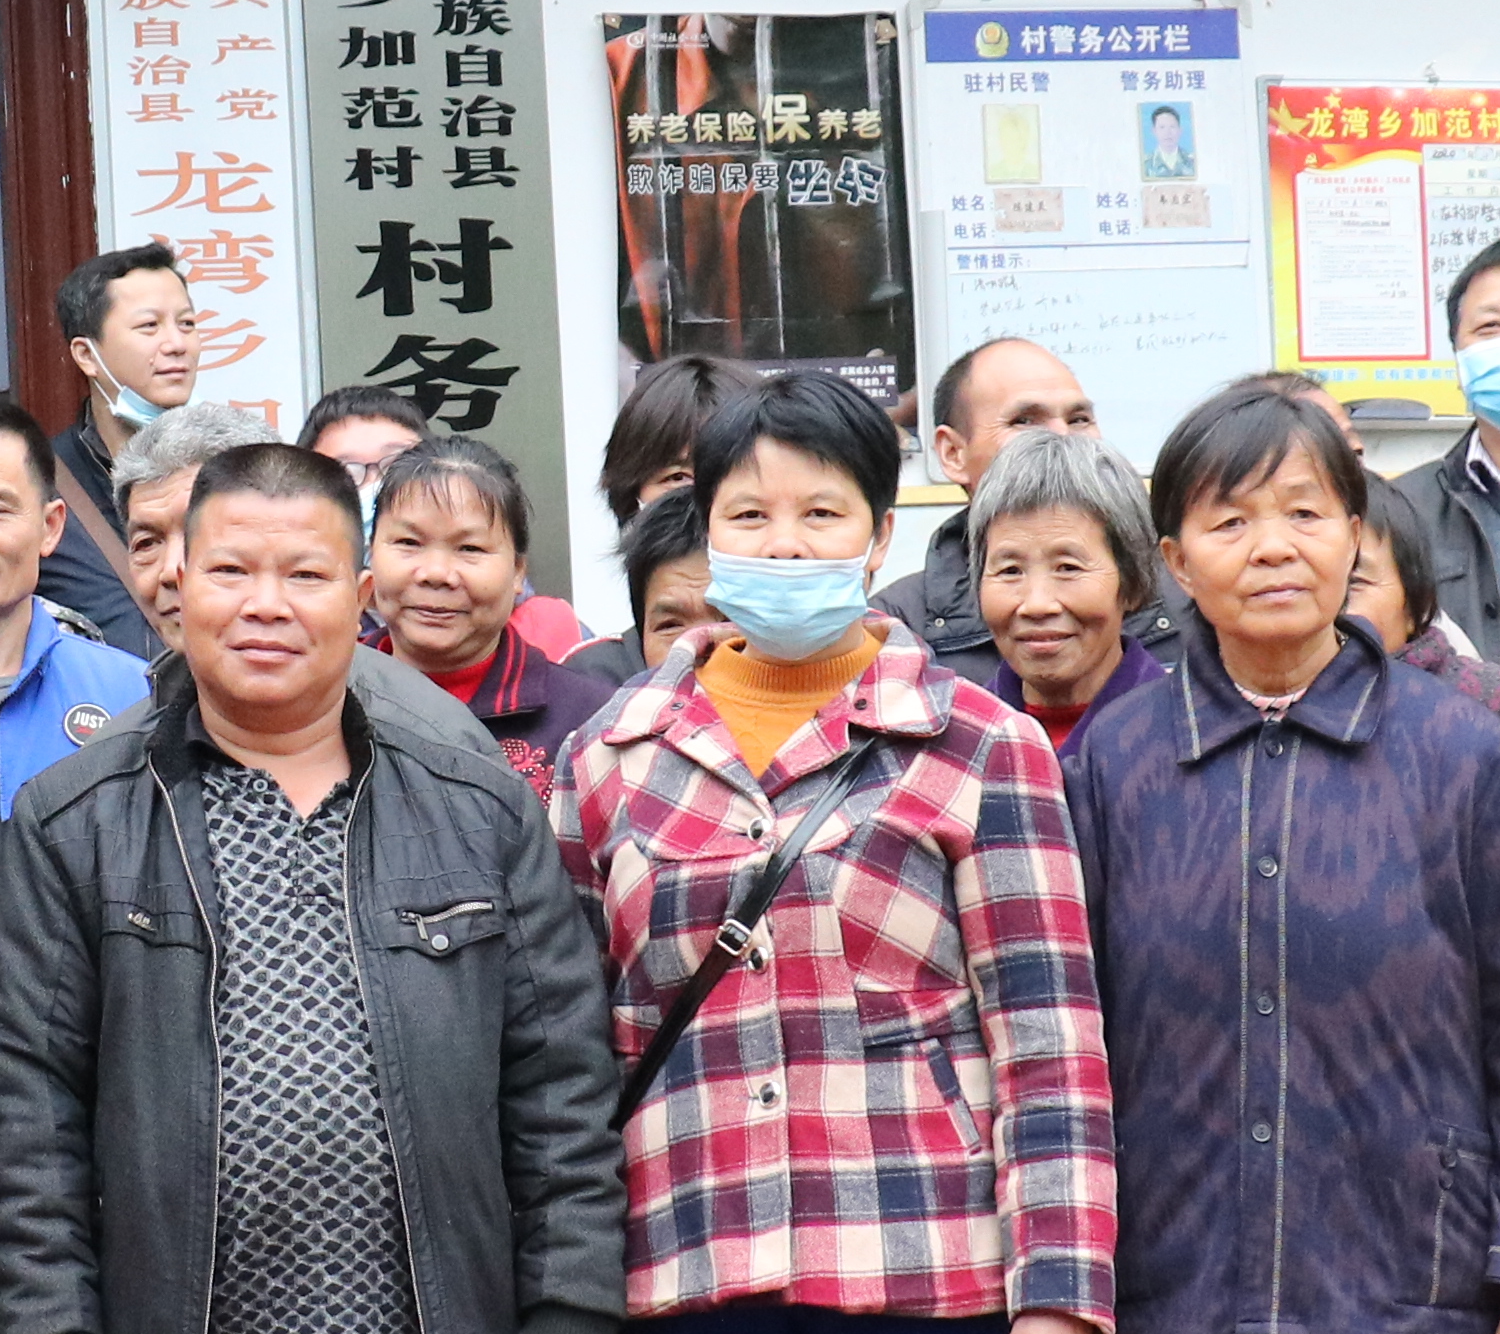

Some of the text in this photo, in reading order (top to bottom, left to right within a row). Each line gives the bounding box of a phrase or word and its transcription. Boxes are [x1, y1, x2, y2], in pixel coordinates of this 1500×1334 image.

[1020, 22, 1191, 54] 村警务公开栏
[964, 69, 1207, 94] 驻村民警 警务助理
[627, 93, 883, 144] 养老保险保养老
[73, 710, 107, 729] JUST
